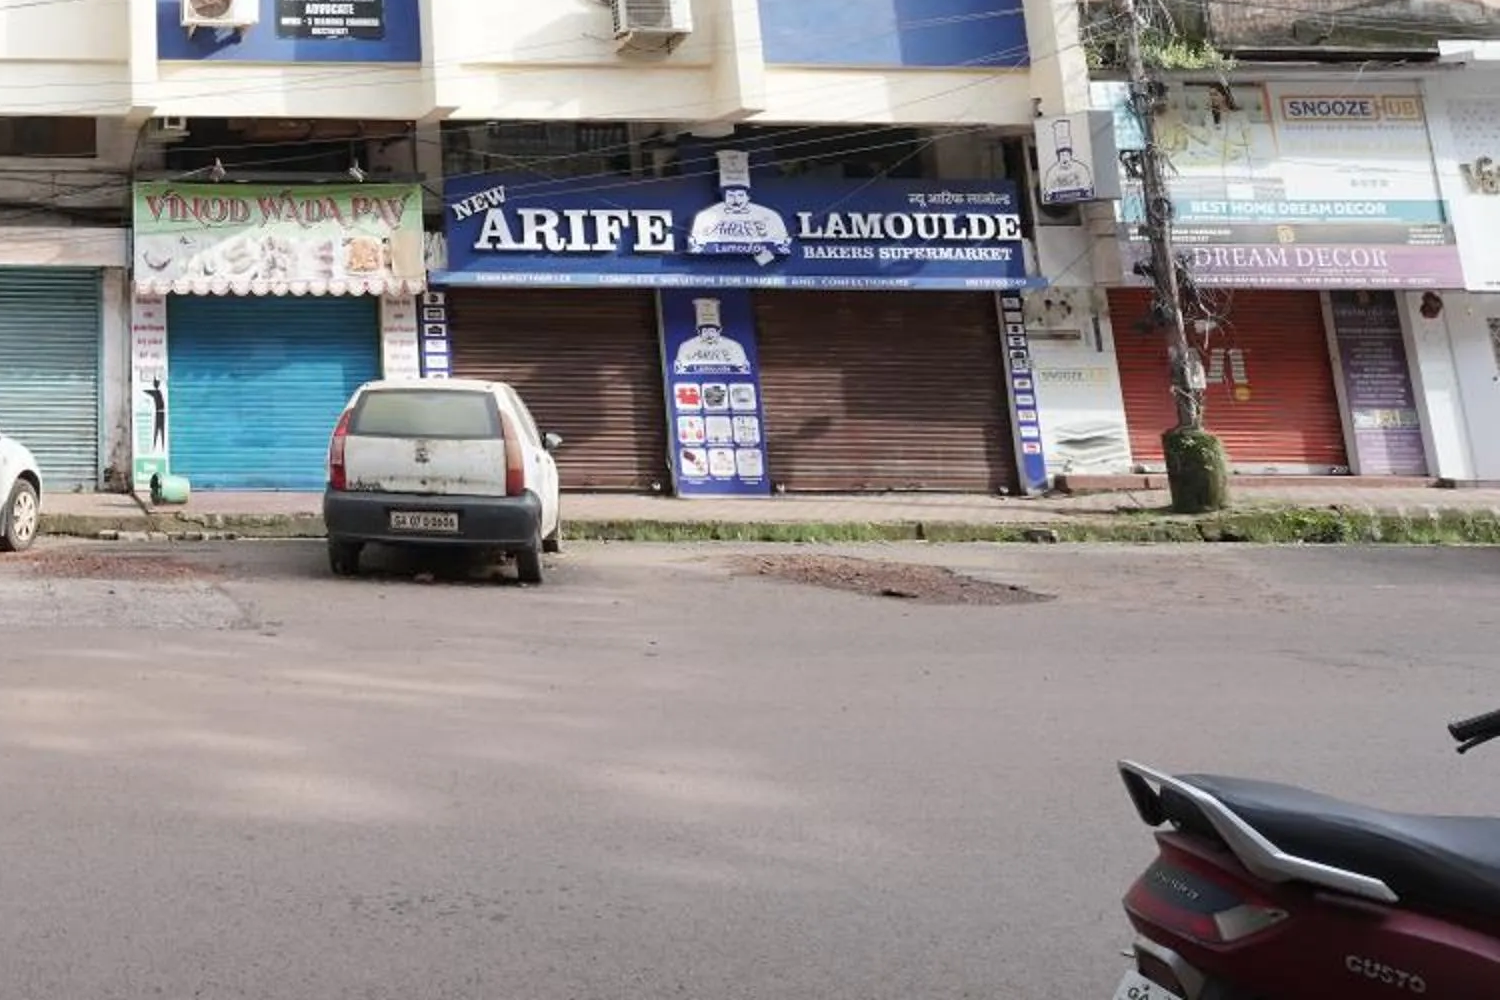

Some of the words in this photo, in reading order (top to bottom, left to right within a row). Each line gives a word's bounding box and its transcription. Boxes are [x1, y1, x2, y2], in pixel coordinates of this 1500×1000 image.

[1288, 100, 1371, 117] SNOOZE
[145, 190, 251, 228] VINOD
[452, 185, 506, 220] NEW
[1191, 201, 1228, 214] BEST
[1231, 201, 1276, 214] HOME
[1278, 201, 1333, 215] DREAM
[1335, 201, 1388, 215] DECOR
[474, 208, 675, 251] ARIFE
[796, 211, 1021, 241] LAMOULDE
[803, 246, 875, 259] BAKERS
[879, 246, 1013, 261] SUPERMARKET
[1192, 247, 1290, 268] DREAM
[1296, 247, 1389, 268] DECOR
[1345, 954, 1427, 993] GUSTO
